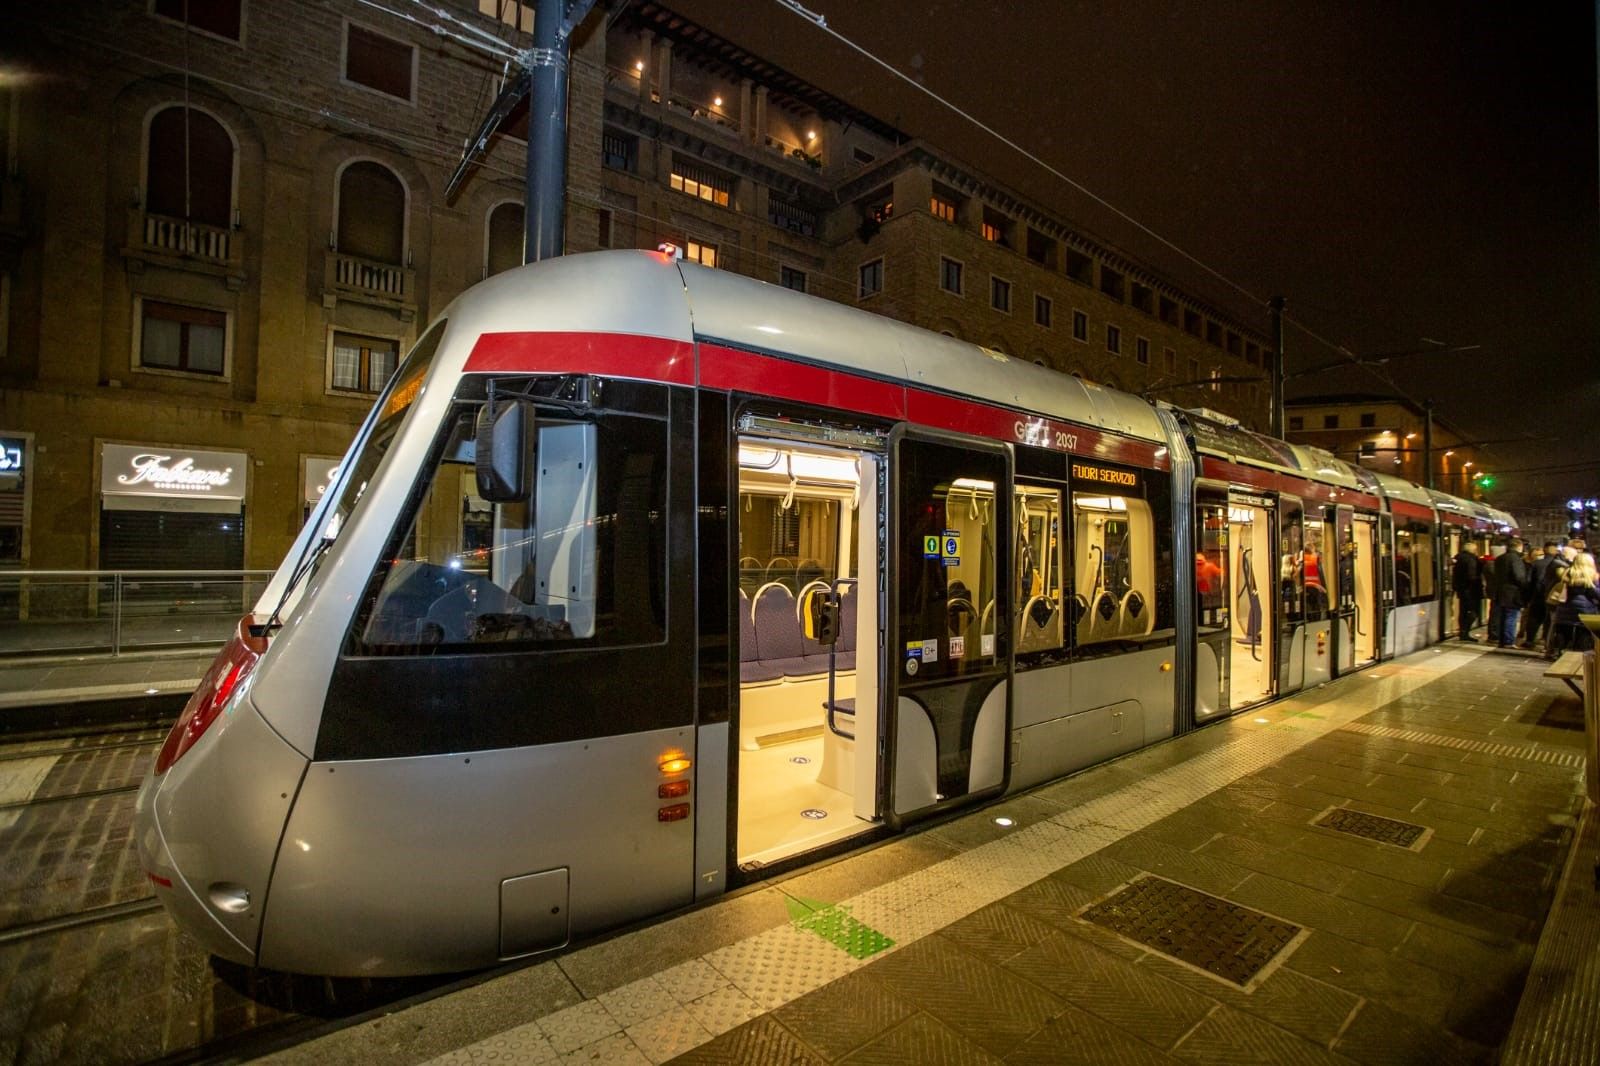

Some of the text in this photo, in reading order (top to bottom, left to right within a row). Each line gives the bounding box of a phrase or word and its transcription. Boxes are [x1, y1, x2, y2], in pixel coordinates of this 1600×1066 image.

[1056, 431, 1077, 450] 2037
[118, 454, 232, 486] Fabiani
[1072, 464, 1136, 486] FUORI SERVIZIO
